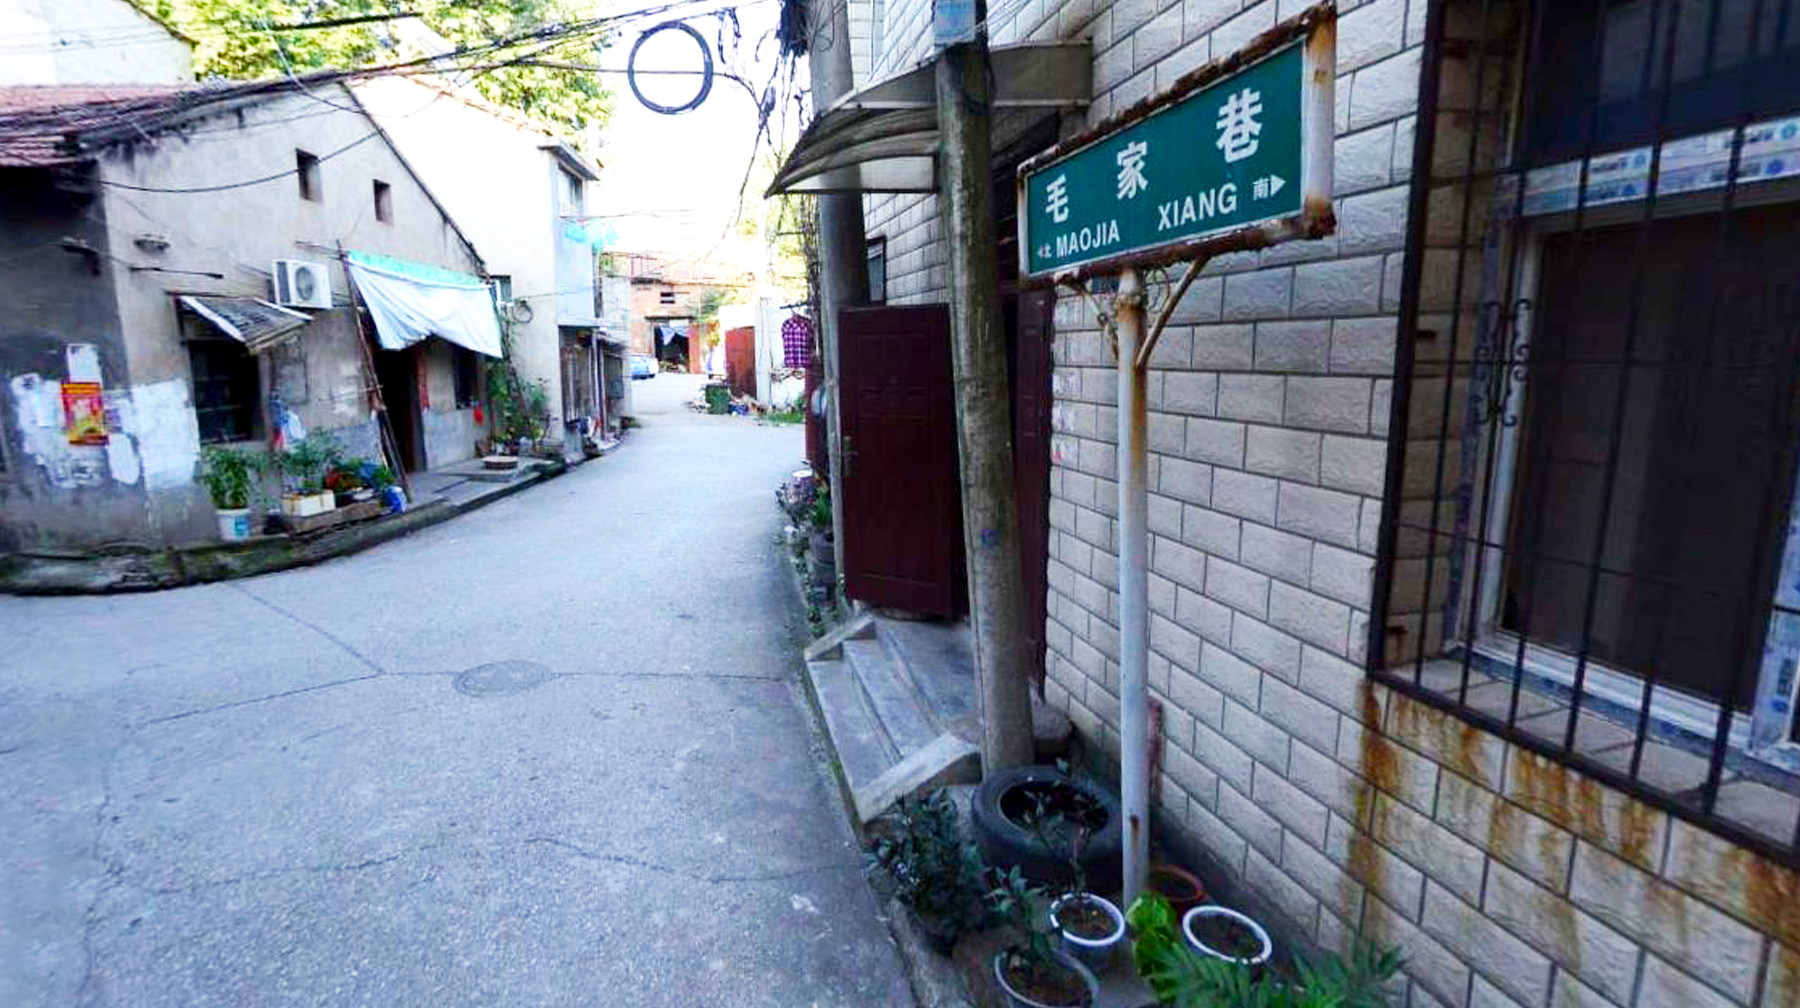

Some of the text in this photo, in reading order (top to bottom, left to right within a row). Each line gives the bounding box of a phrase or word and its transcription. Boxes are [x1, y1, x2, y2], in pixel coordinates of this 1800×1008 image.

[1045, 87, 1262, 223] 毛家巷
[1252, 177, 1269, 200] 南
[1056, 182, 1237, 258] MAOJIA XIANG
